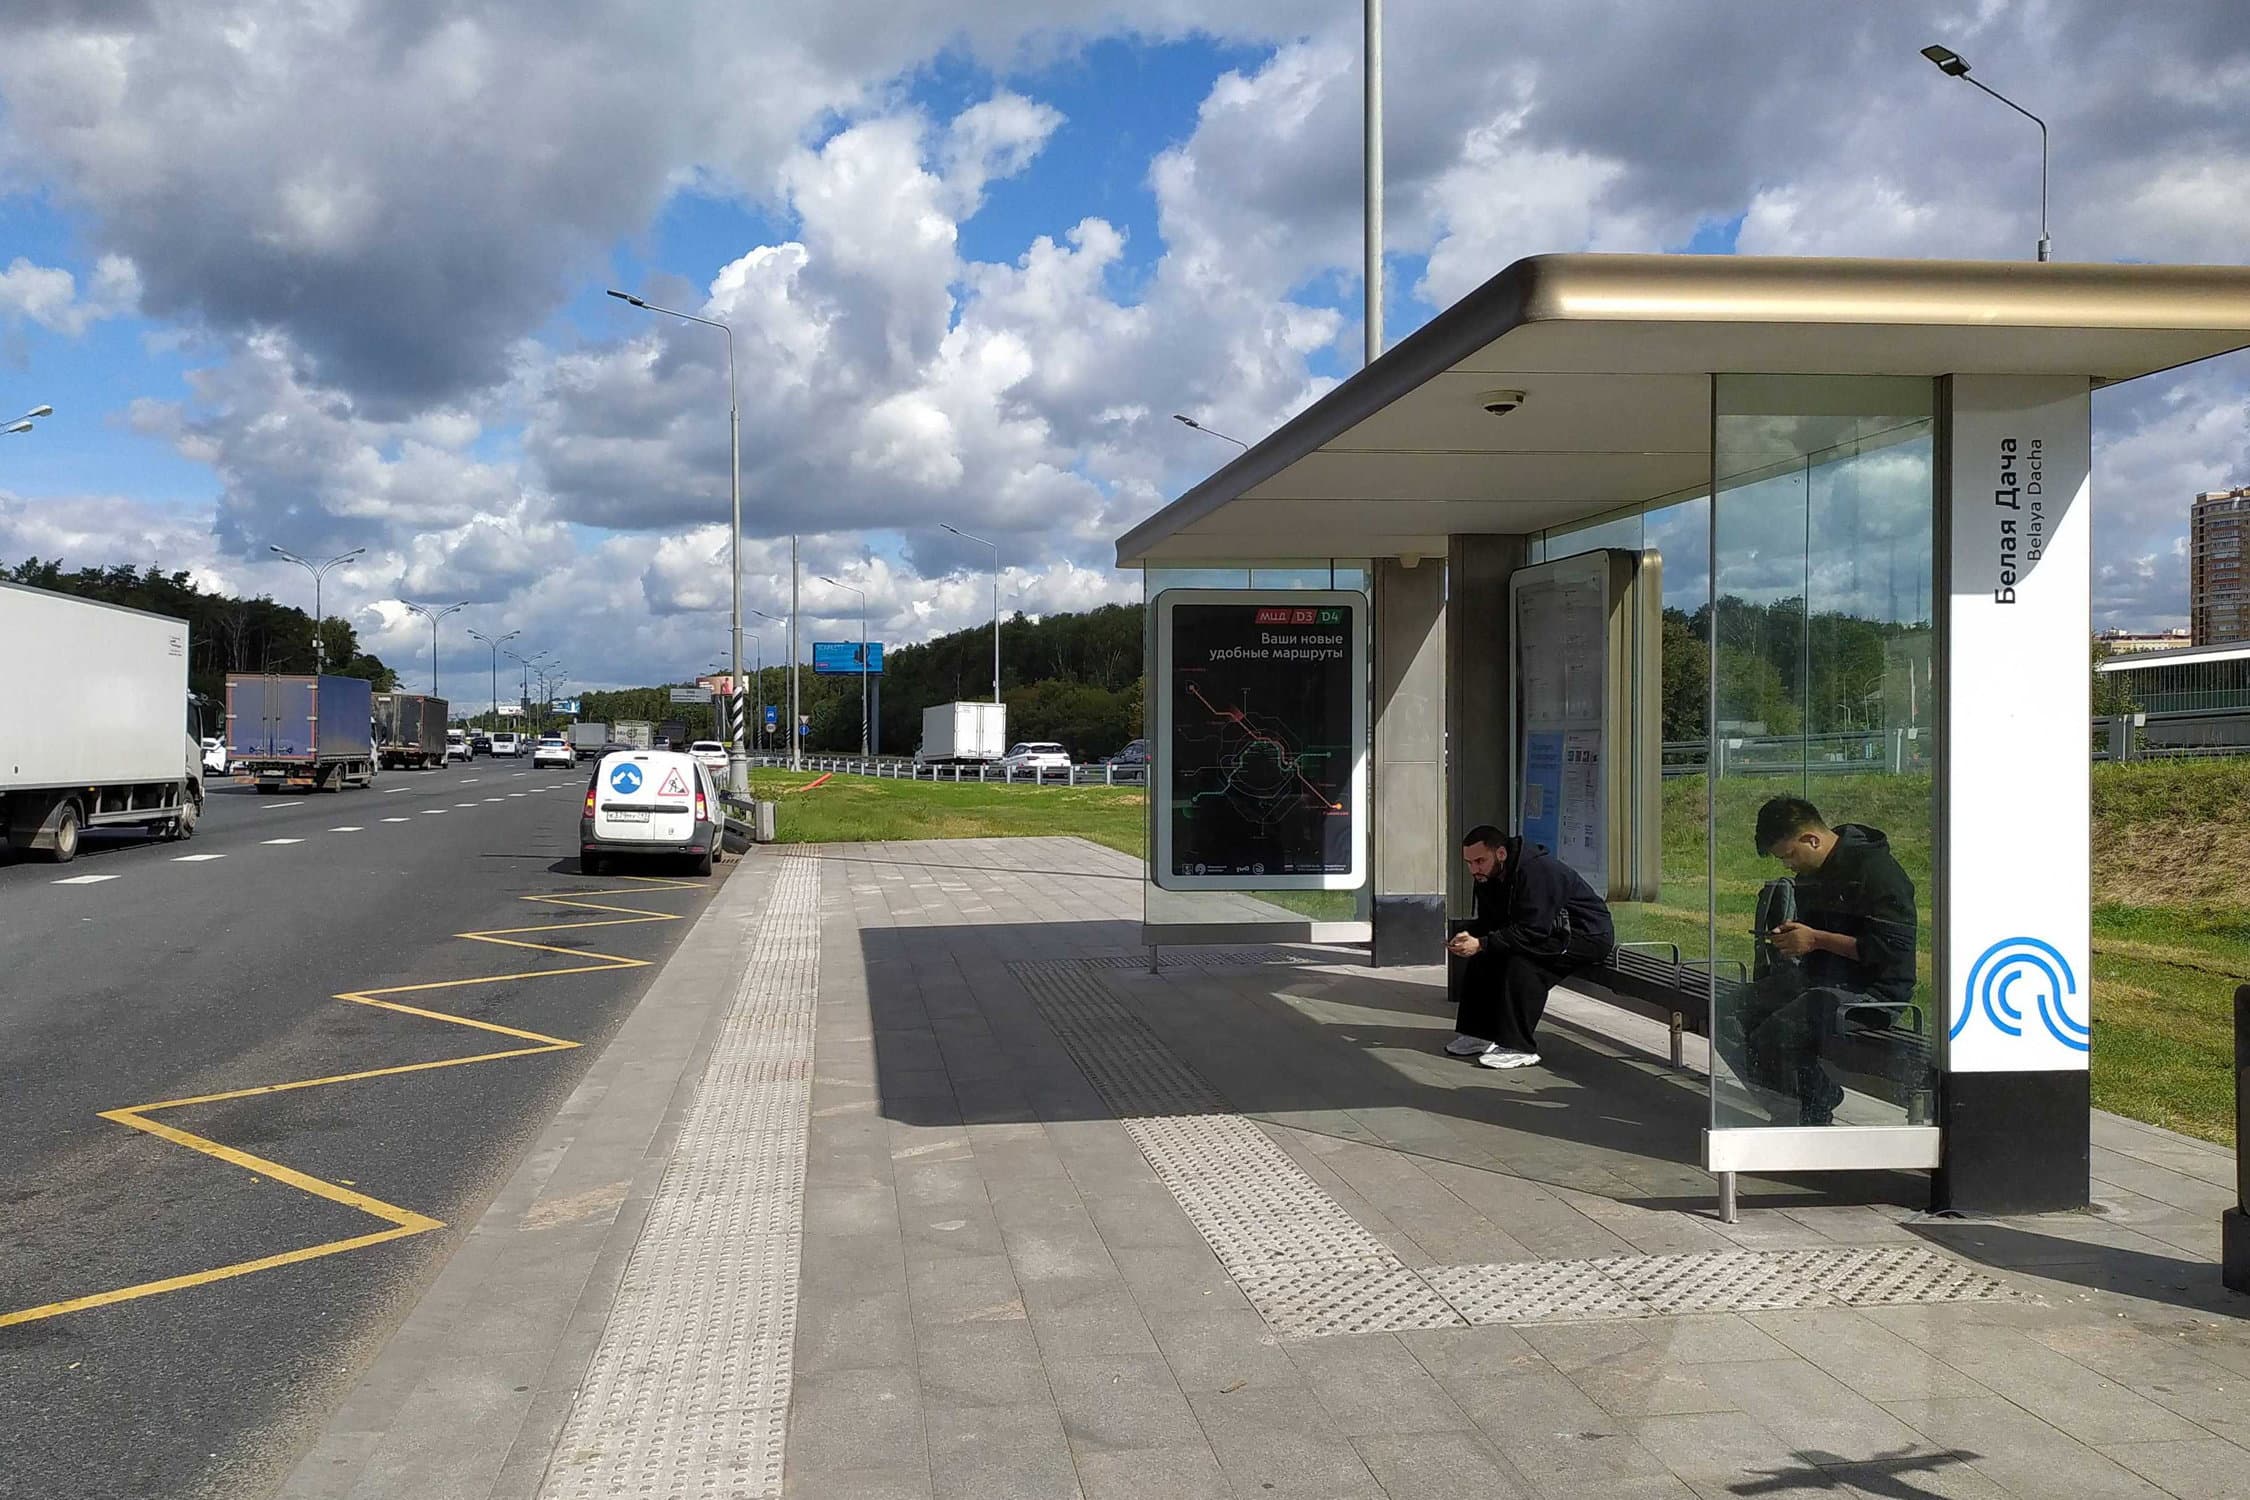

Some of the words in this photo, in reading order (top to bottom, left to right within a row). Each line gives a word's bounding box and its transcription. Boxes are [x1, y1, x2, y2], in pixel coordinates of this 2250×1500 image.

[1995, 437, 2021, 511] Дача
[2027, 439, 2043, 496] Dacha
[2027, 501, 2044, 561] Belaya
[1994, 519, 2017, 604] Белая
[1259, 612, 1288, 622] МЦД
[1295, 612, 1313, 622] D3
[1321, 612, 1339, 622] D4
[1261, 632, 1297, 644] Ваши
[1301, 635, 1343, 644] новые
[1209, 646, 1269, 661] удобные
[1272, 649, 1343, 661] маршруты
